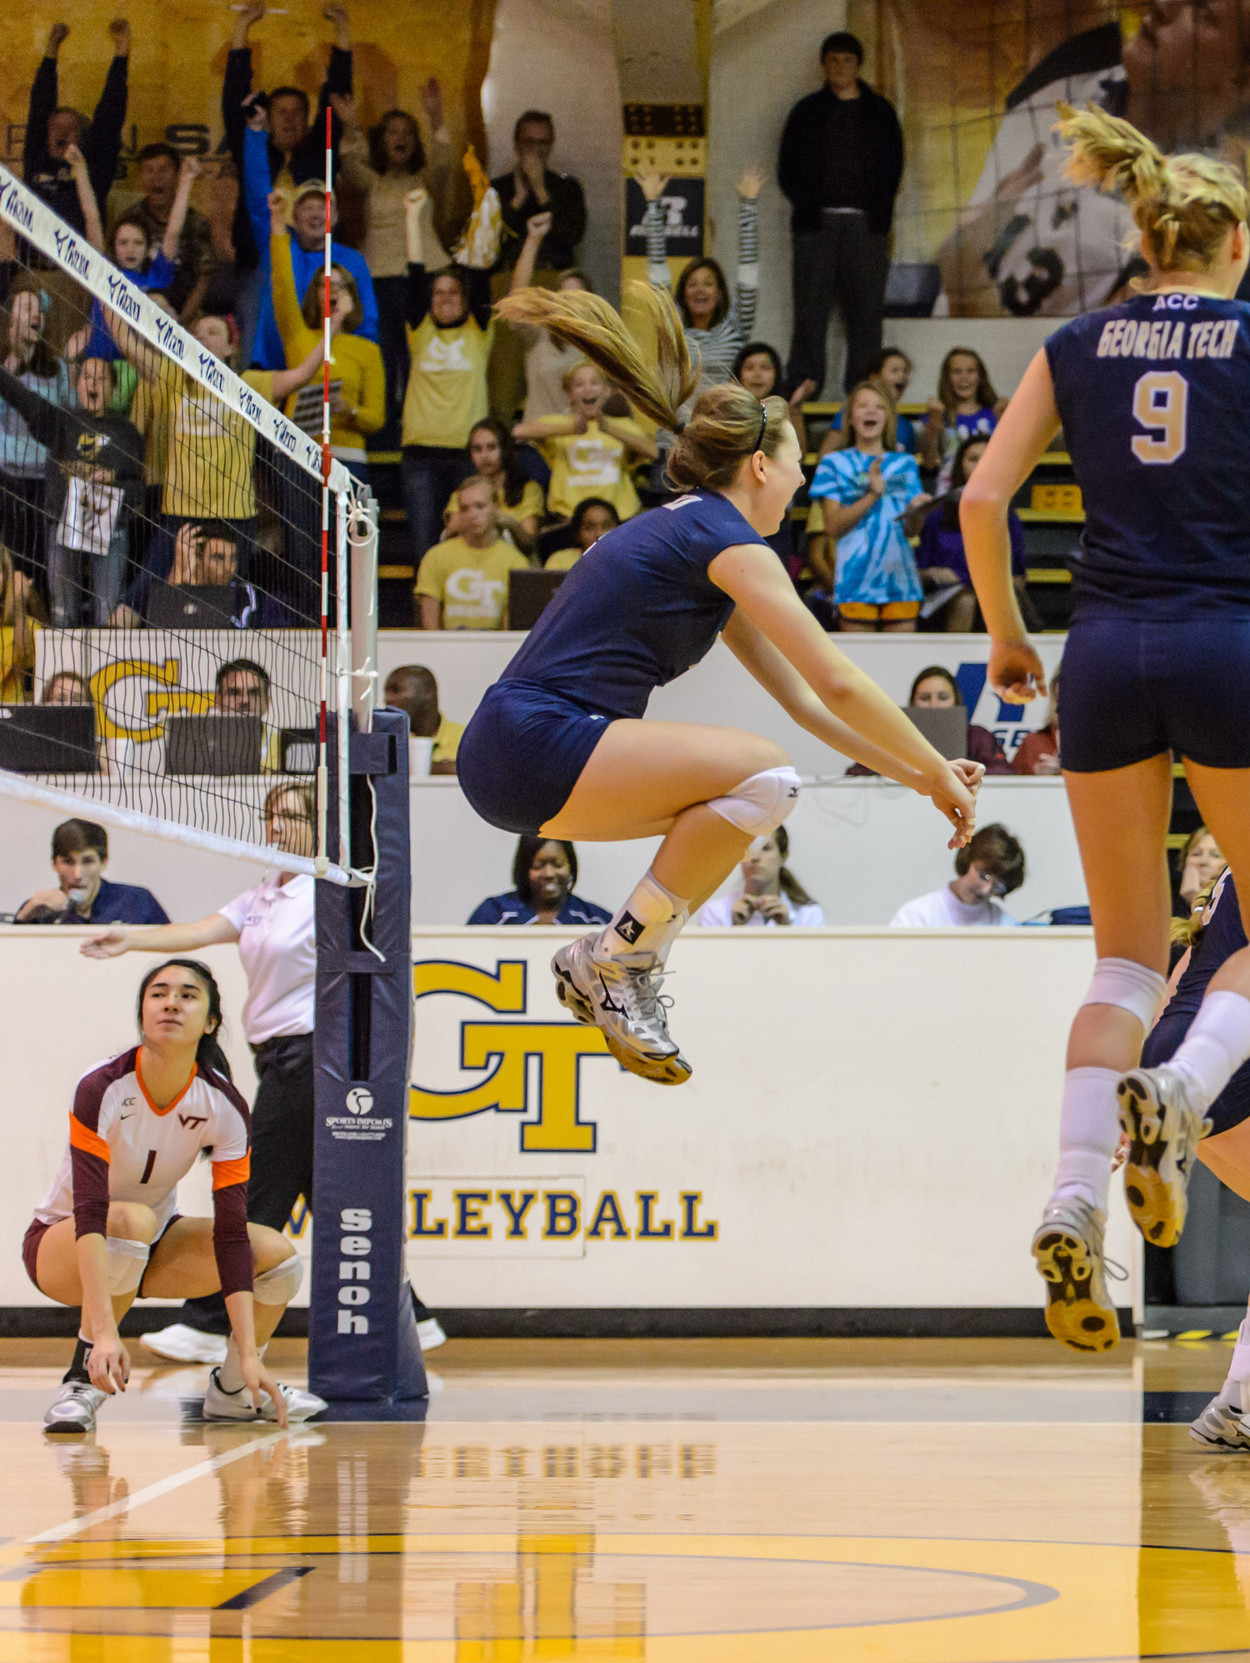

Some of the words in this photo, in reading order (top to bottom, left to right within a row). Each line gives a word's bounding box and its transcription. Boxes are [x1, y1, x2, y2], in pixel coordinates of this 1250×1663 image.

[1152, 294, 1199, 311] ACC
[1096, 319, 1186, 360] GEORGIA
[1186, 319, 1240, 359] TECH
[1131, 370, 1189, 465] 9
[407, 958, 629, 1153] GT
[177, 1113, 208, 1130] VT
[140, 1149, 157, 1184] 1
